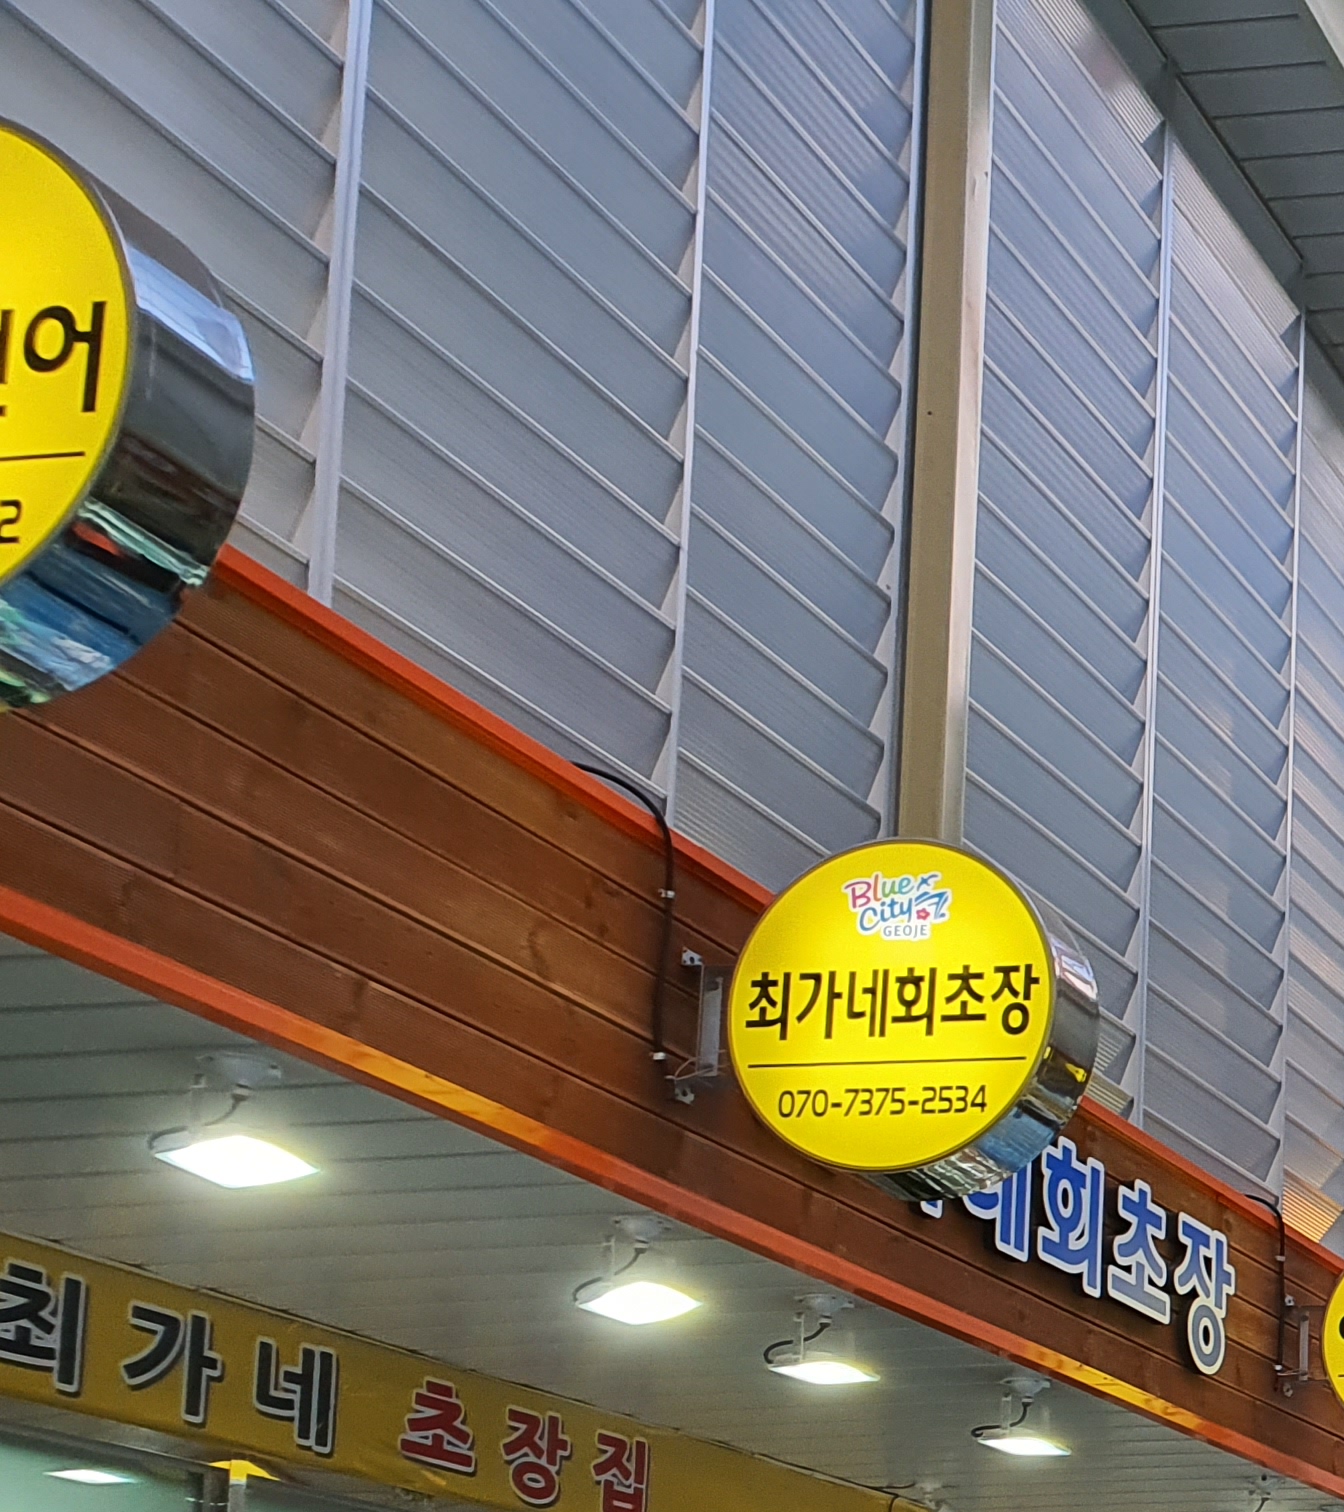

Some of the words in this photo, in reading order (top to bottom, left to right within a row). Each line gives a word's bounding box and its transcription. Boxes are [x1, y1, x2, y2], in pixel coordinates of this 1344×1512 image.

[0, 301, 106, 413] 어
[845, 873, 913, 910] Blue
[859, 898, 914, 931] City
[882, 923, 929, 939] GEOJE
[745, 963, 1040, 1041] 최가네회초장
[777, 1084, 988, 1119] 070-7375-2534
[0, 1260, 337, 1456] 최가네
